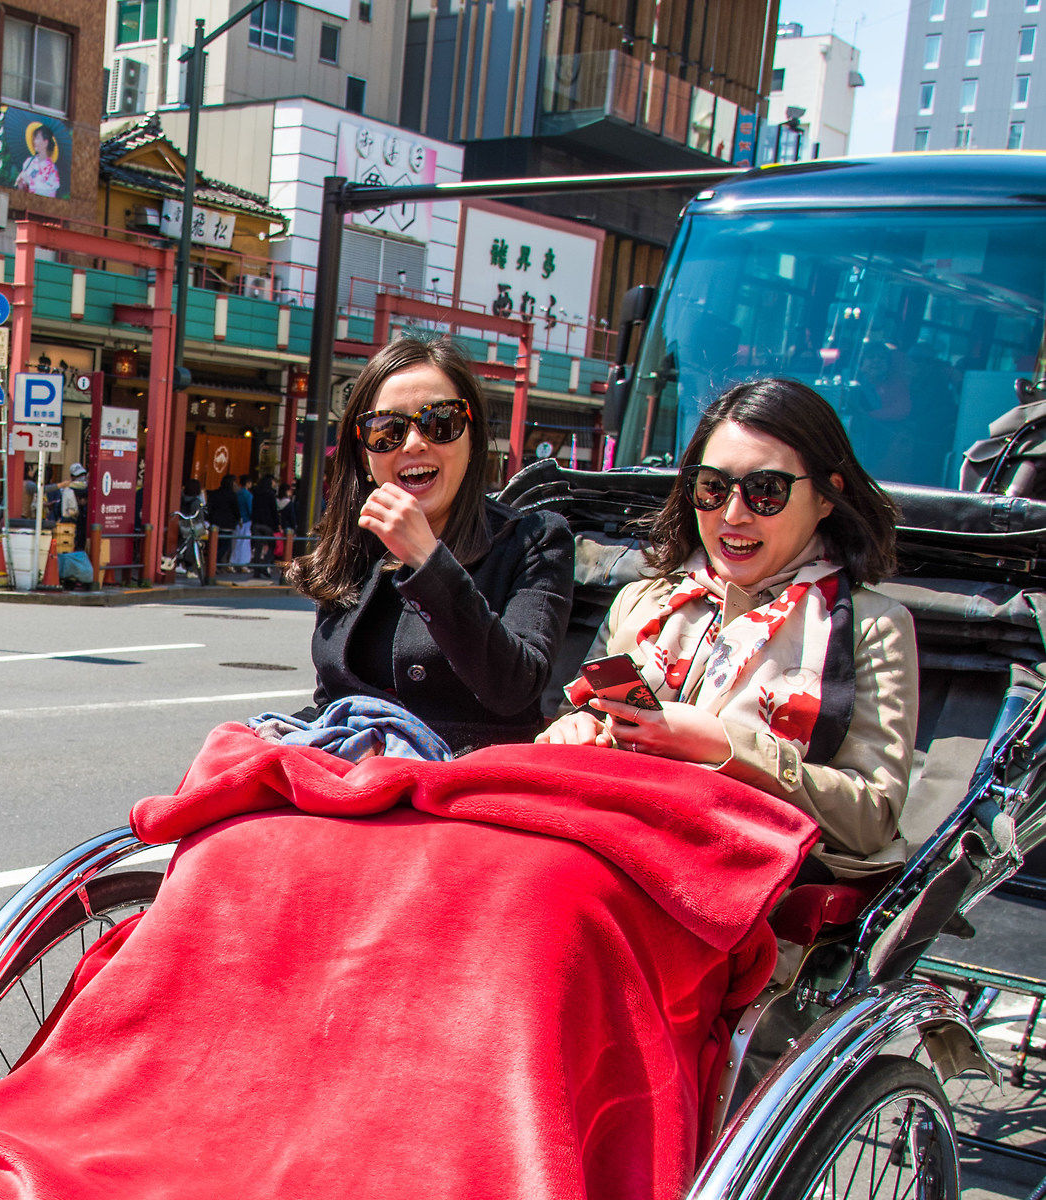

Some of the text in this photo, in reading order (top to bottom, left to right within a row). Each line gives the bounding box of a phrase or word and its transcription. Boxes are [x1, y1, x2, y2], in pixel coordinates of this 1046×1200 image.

[25, 379, 56, 418] P
[38, 430, 59, 439] この先
